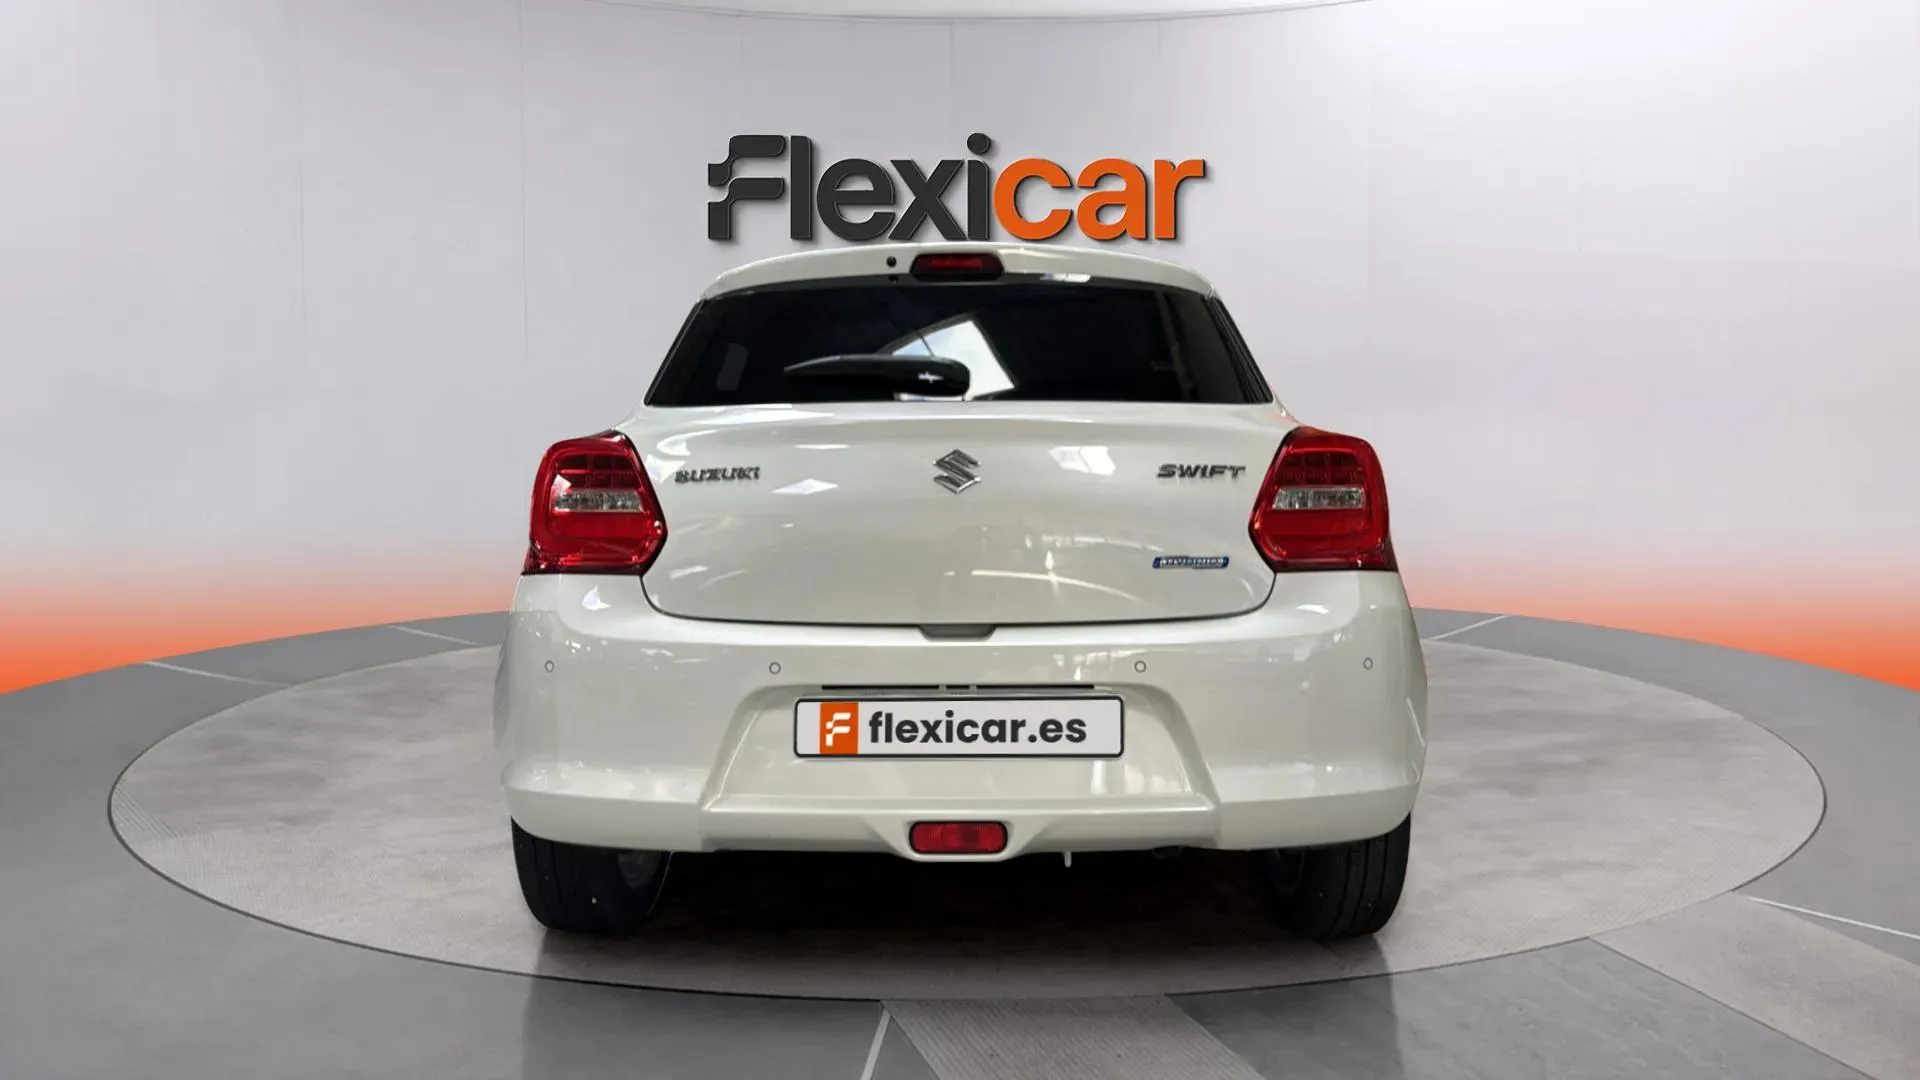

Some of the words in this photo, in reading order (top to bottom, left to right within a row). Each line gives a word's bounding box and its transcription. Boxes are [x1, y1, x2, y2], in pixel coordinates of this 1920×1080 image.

[708, 133, 1206, 241] Flexicar
[675, 466, 760, 483] SUZUKI
[1157, 464, 1246, 479] SWIFT
[869, 710, 1087, 743] flexicar.es
